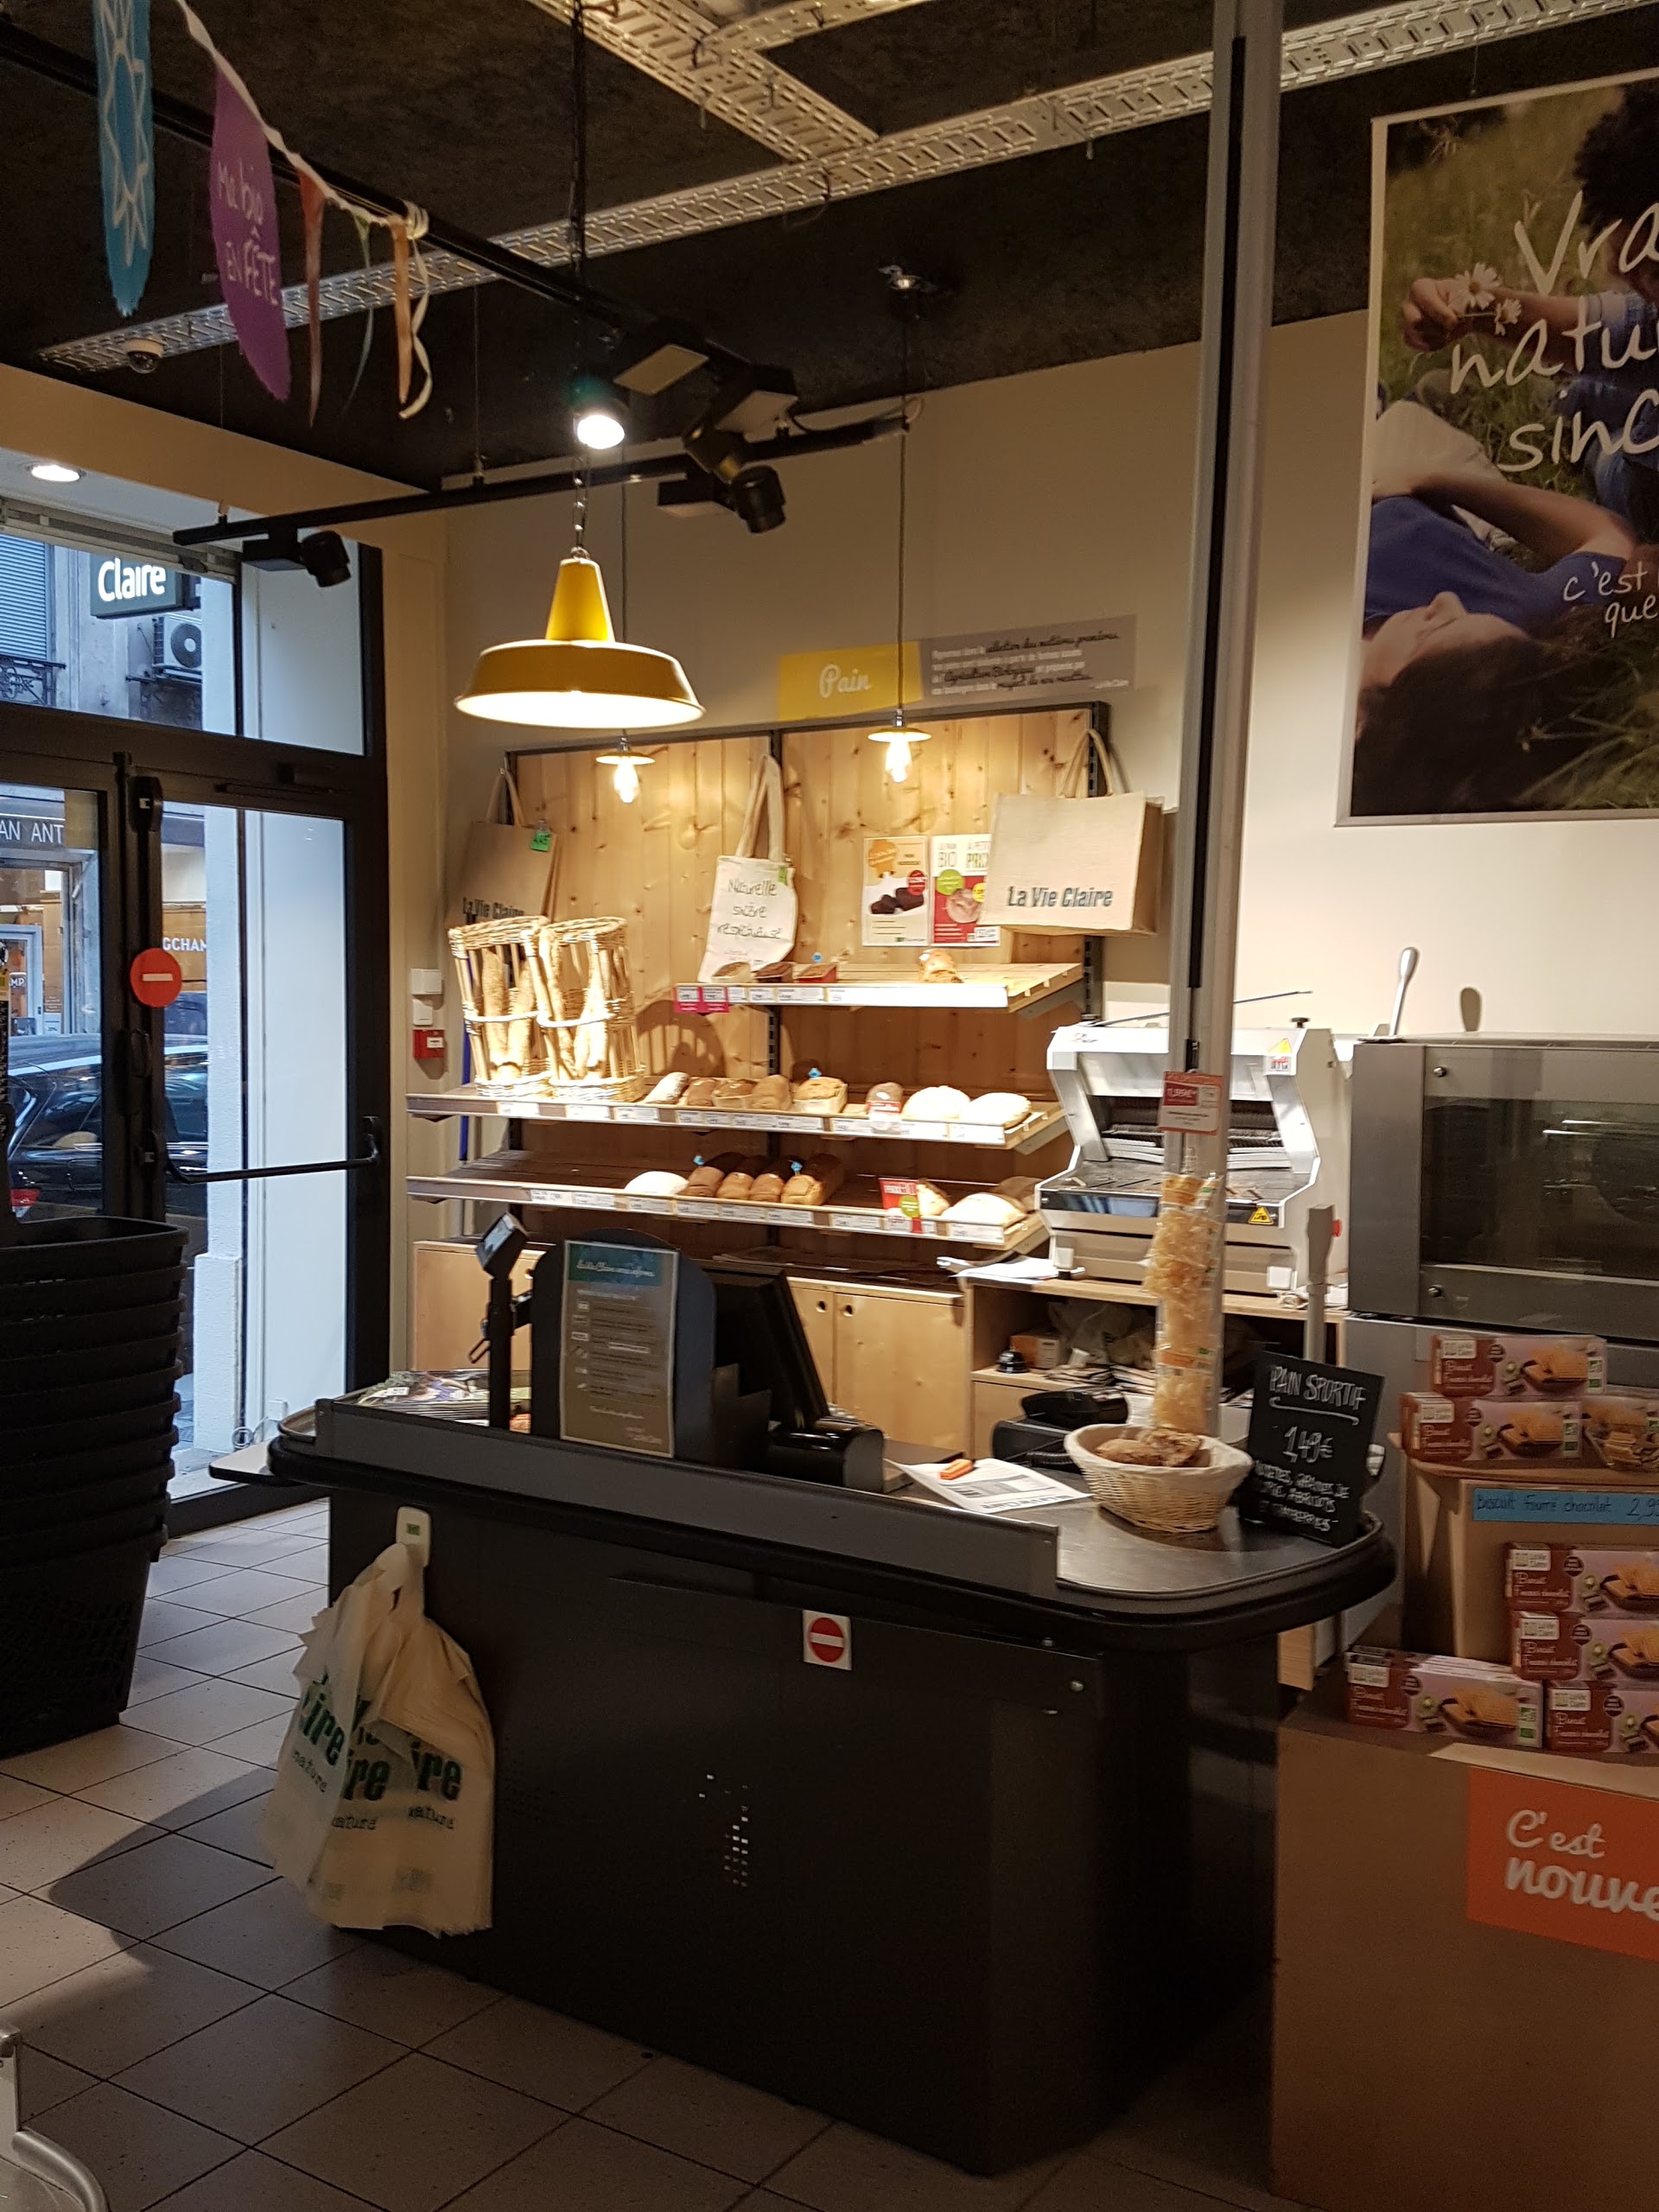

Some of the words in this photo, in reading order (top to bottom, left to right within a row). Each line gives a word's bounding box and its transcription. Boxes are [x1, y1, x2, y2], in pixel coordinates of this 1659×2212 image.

[242, 226, 278, 306] FÊTE
[1514, 189, 1659, 297] Vra
[1450, 296, 1659, 395] natu
[98, 557, 167, 602] Claire
[1563, 561, 1649, 602] c'est
[1605, 592, 1658, 639] que
[818, 663, 873, 699] Pain
[1007, 886, 1027, 907] La
[1032, 887, 1058, 907] Vie
[1060, 887, 1114, 908] Claire
[1269, 1366, 1303, 1396] PAIN
[1303, 1374, 1367, 1411] SPORTIF
[300, 1689, 345, 1765] ire
[1507, 1809, 1607, 1859] C'est
[1506, 1856, 1659, 1922] nouve
